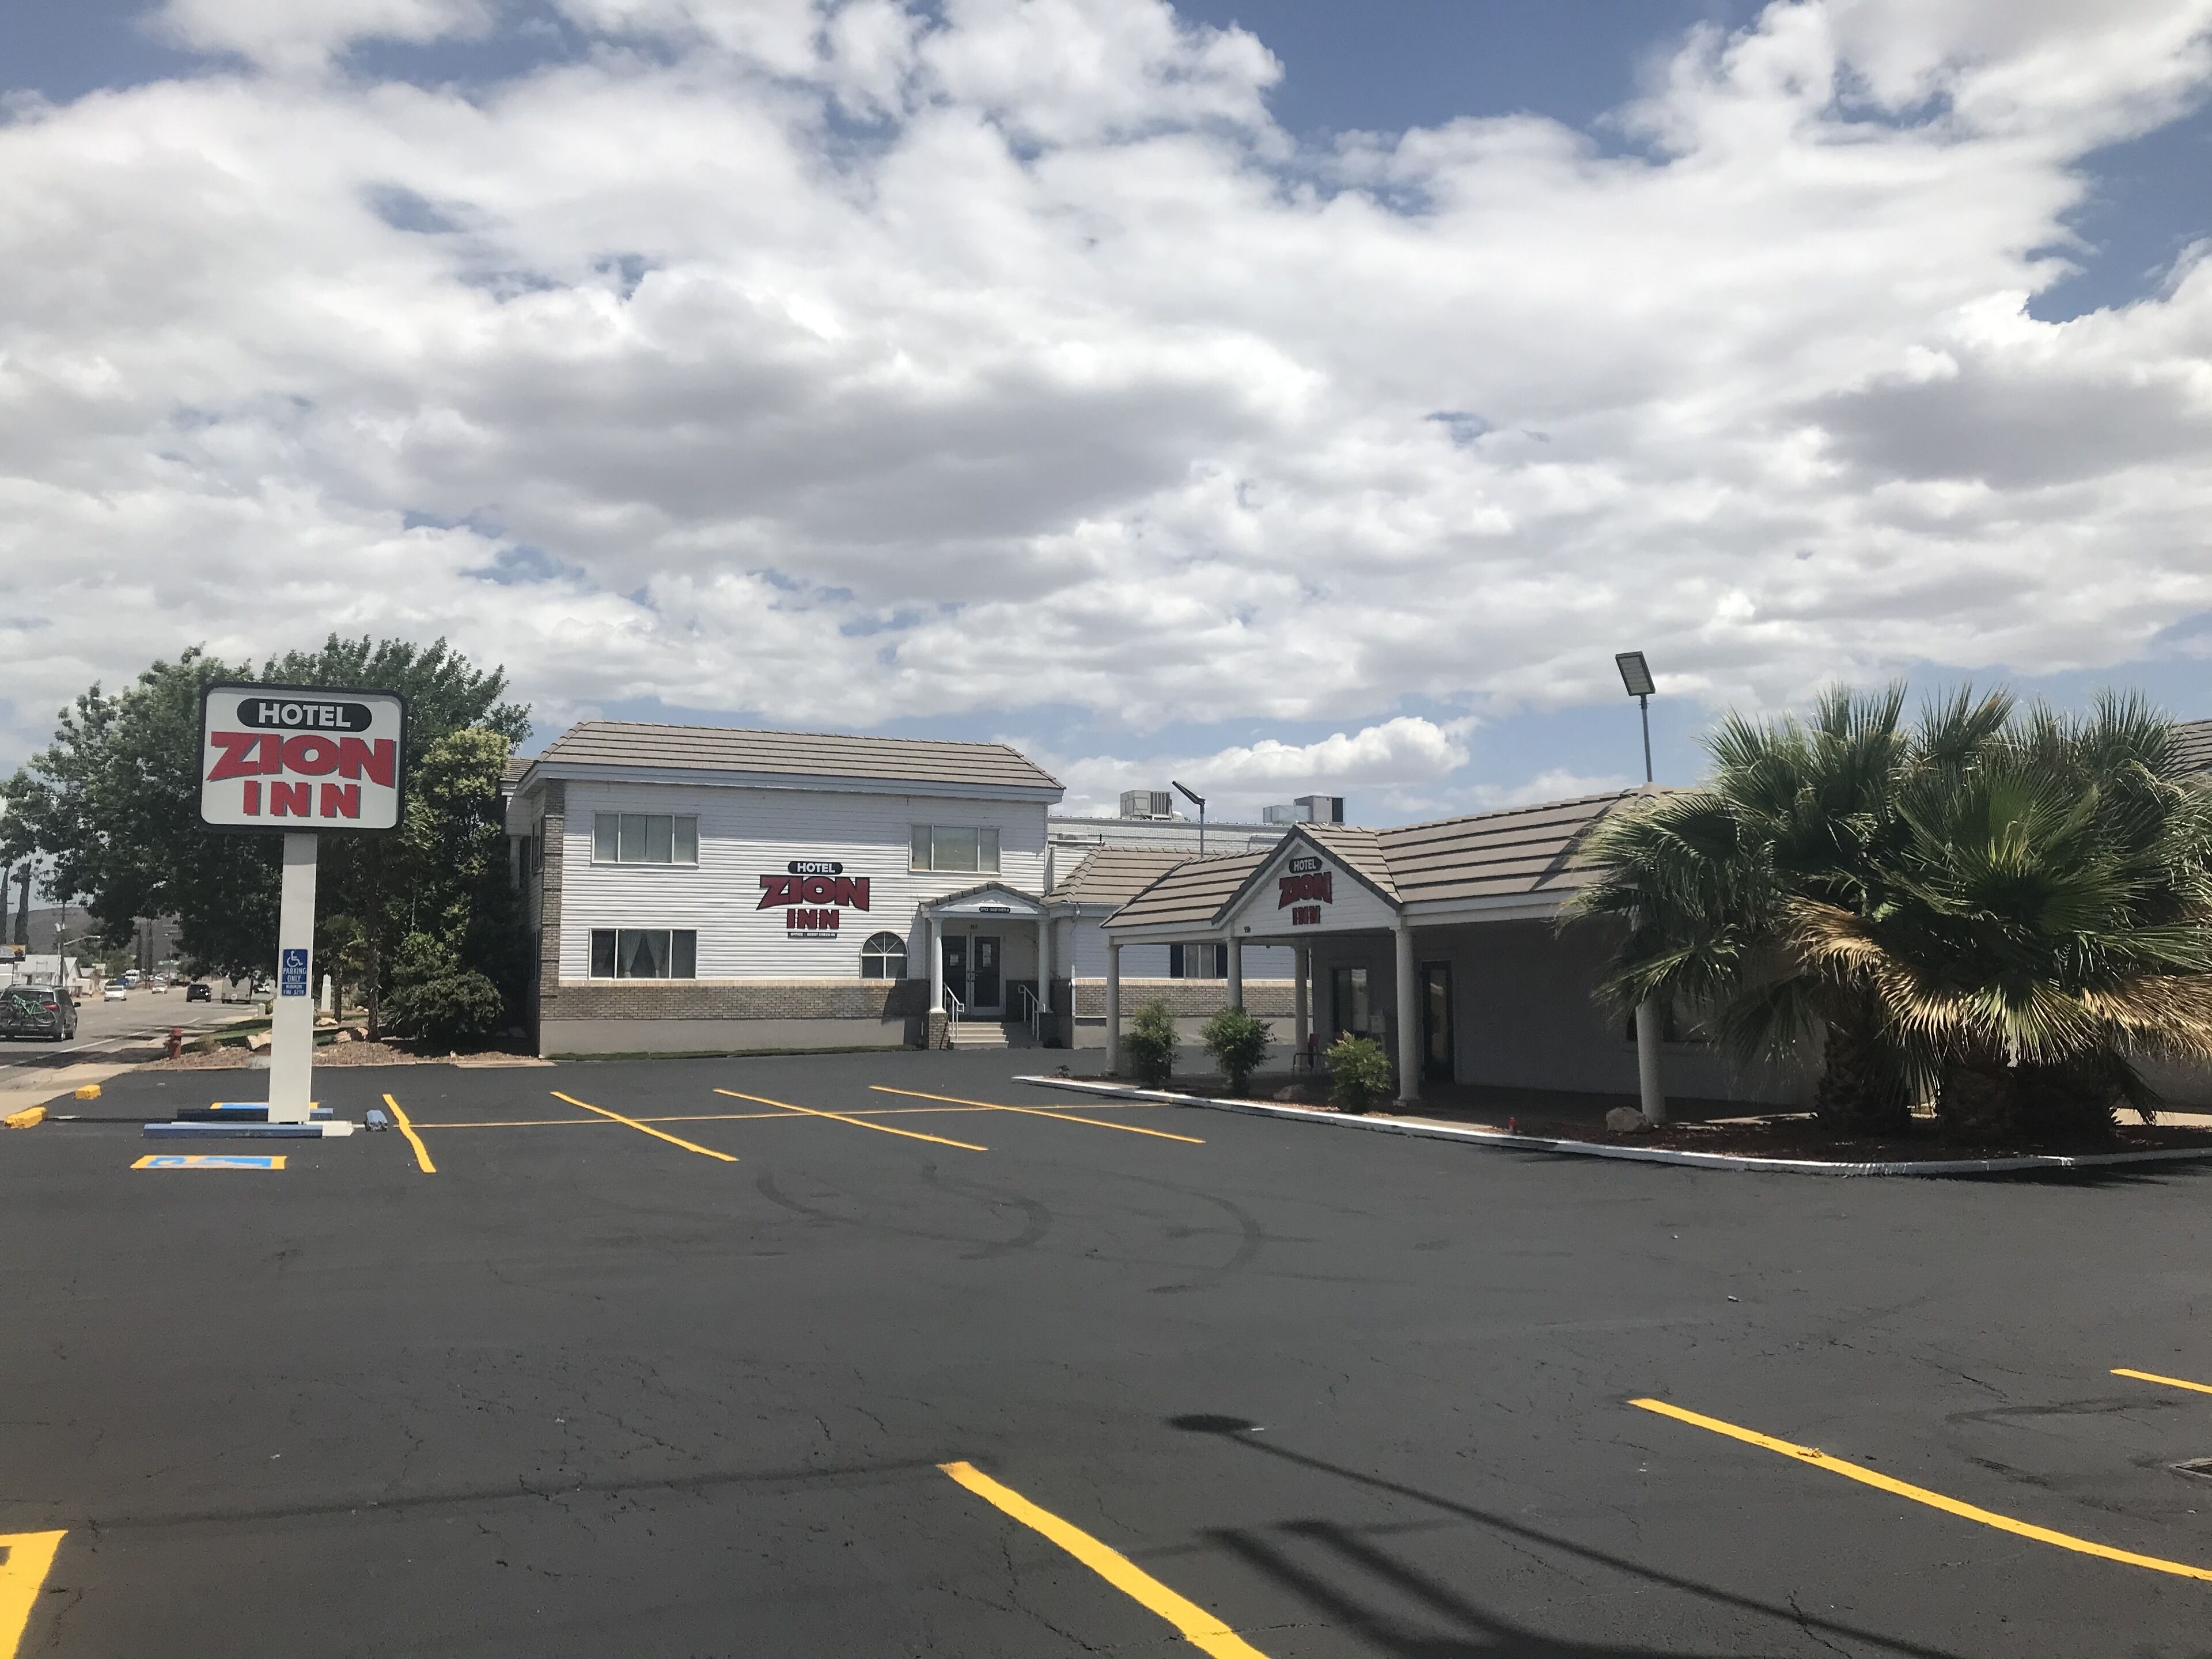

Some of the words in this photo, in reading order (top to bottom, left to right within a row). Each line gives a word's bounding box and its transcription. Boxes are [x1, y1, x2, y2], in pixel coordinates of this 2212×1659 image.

[258, 702, 351, 728] HOTEL
[206, 731, 396, 789] ZION
[243, 780, 361, 819] INN
[797, 862, 835, 873] HOTEL
[1294, 858, 1316, 872] HOTEL
[756, 874, 870, 912] ZION
[1278, 871, 1332, 910] ZION
[786, 908, 839, 930] INN
[1292, 905, 1321, 926] INN
